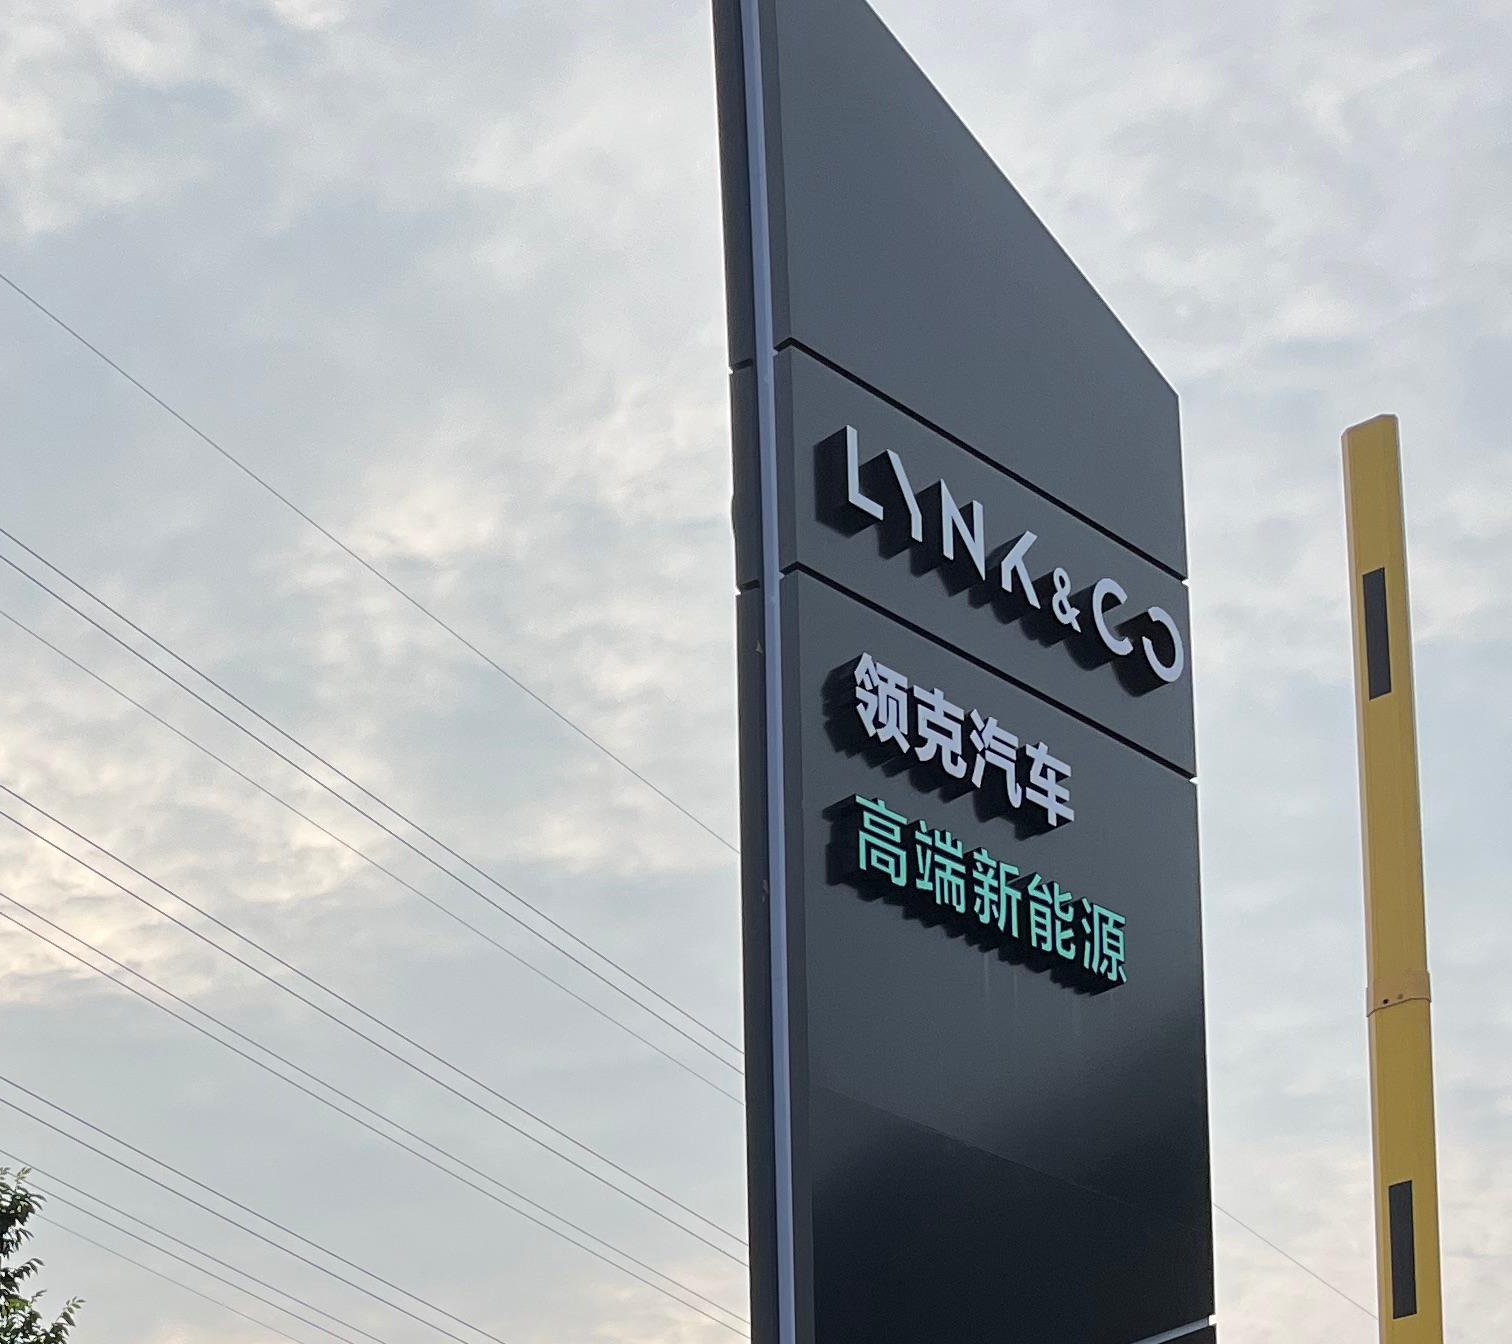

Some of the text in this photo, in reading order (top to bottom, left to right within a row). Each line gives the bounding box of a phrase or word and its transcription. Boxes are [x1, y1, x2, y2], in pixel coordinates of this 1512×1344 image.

[854, 652, 1075, 828] 领克汽车
[855, 794, 1128, 984] 高端新能源
